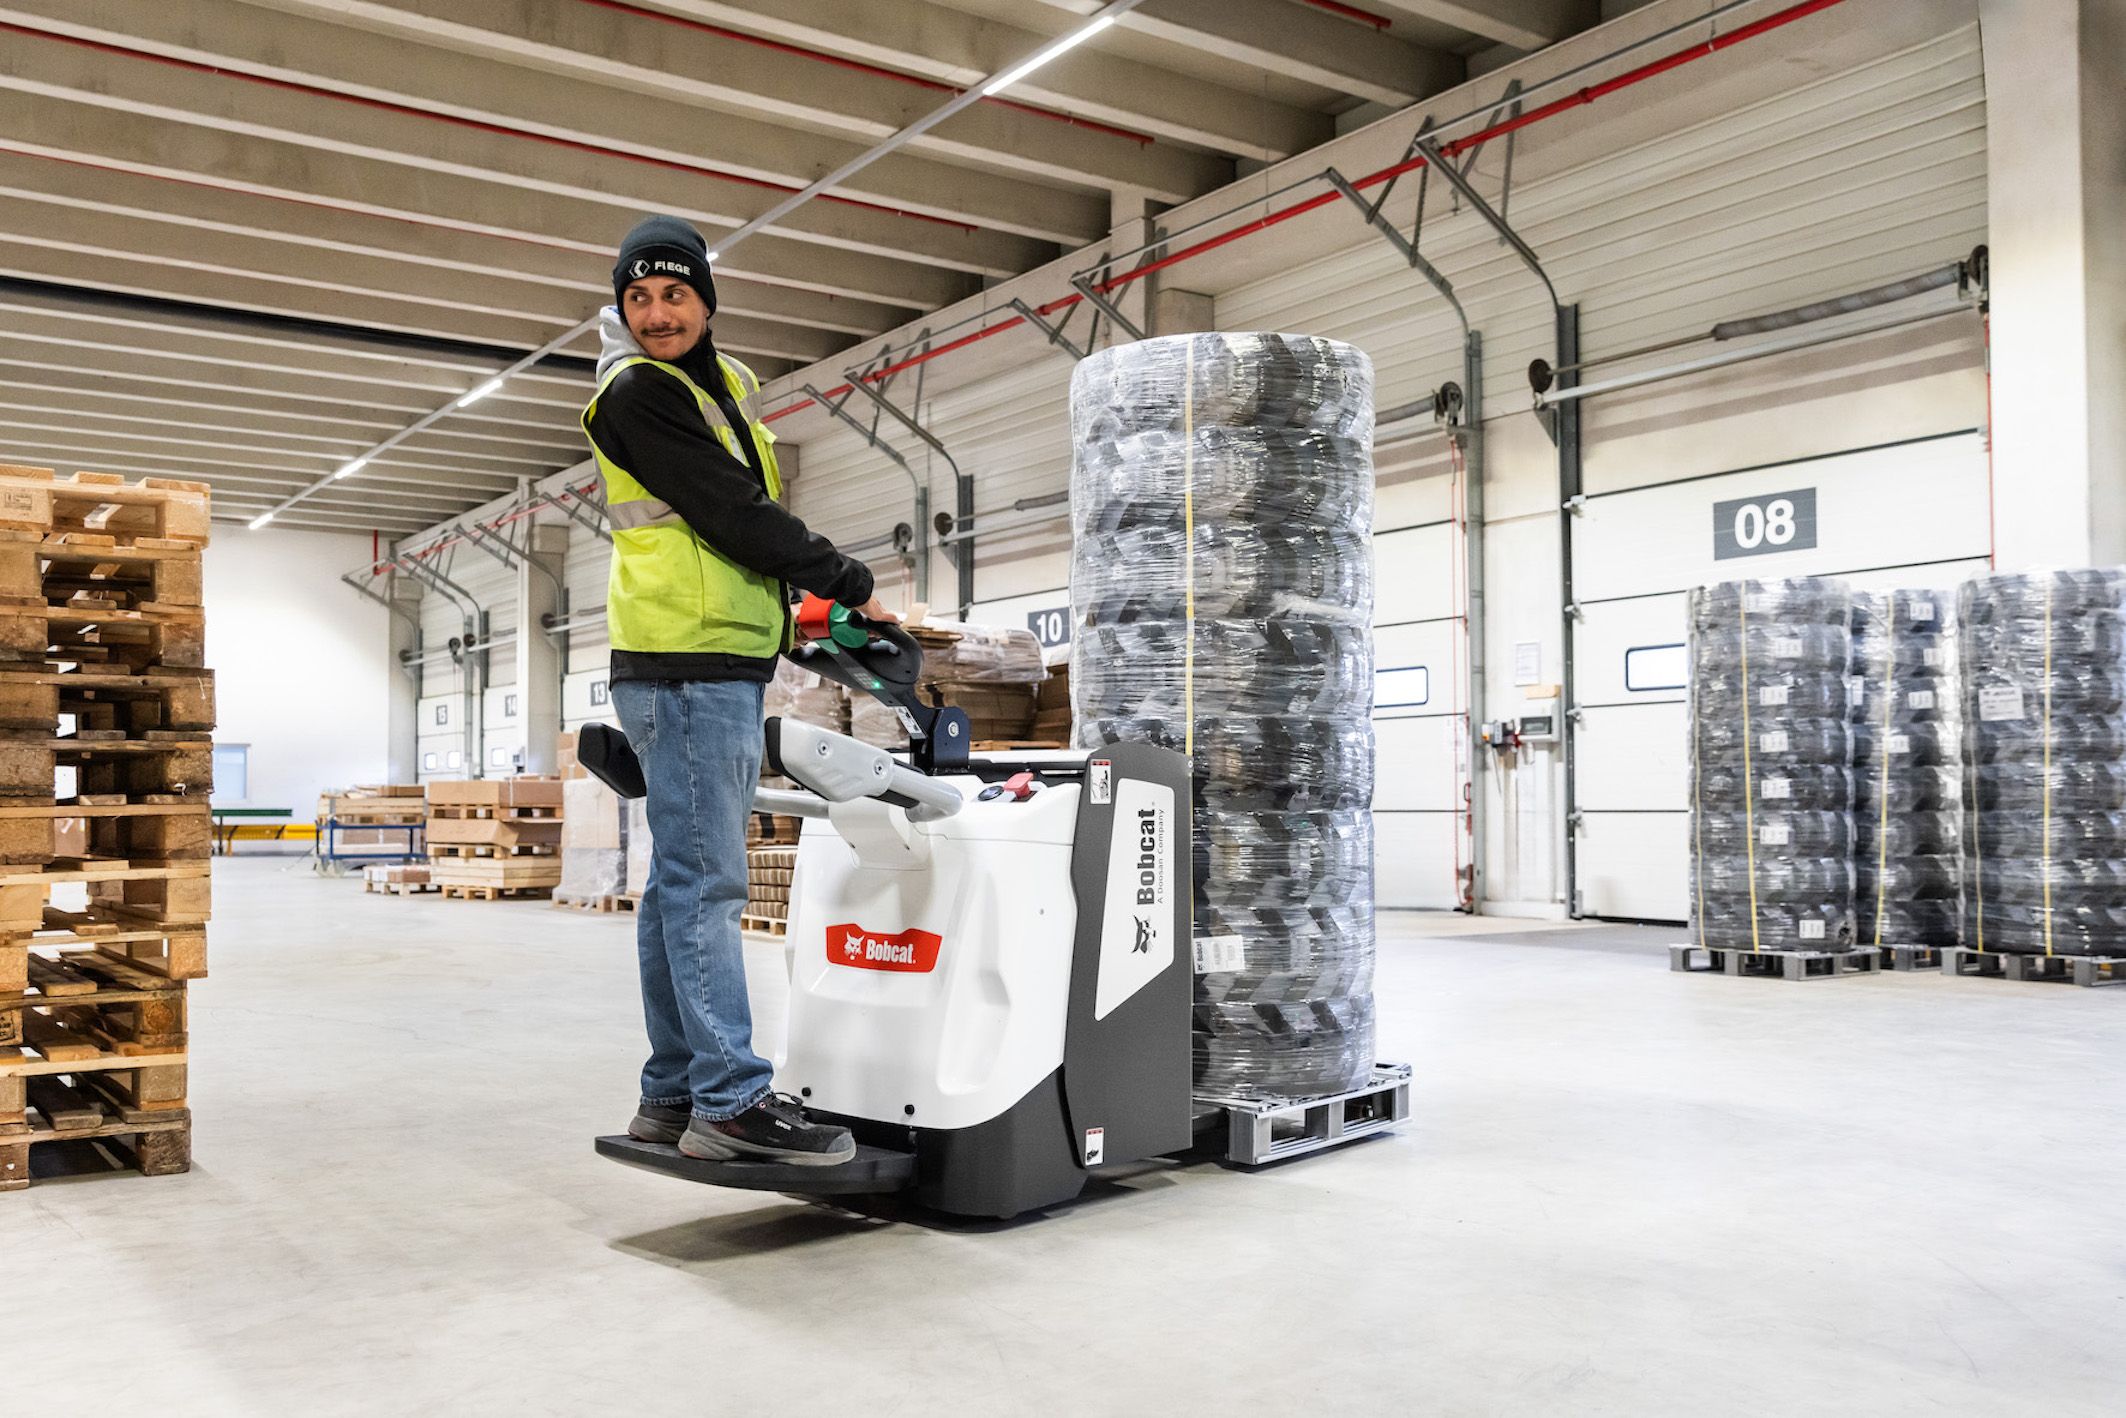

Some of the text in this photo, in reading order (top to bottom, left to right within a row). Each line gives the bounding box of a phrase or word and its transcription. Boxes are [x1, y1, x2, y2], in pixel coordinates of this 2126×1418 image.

[654, 260, 692, 276] FIEGE
[1734, 498, 1796, 549] 08
[1036, 612, 1063, 643] 10
[1157, 809, 1165, 854] Company
[1137, 808, 1155, 905] Bobcat
[865, 938, 914, 964] Bobcat
